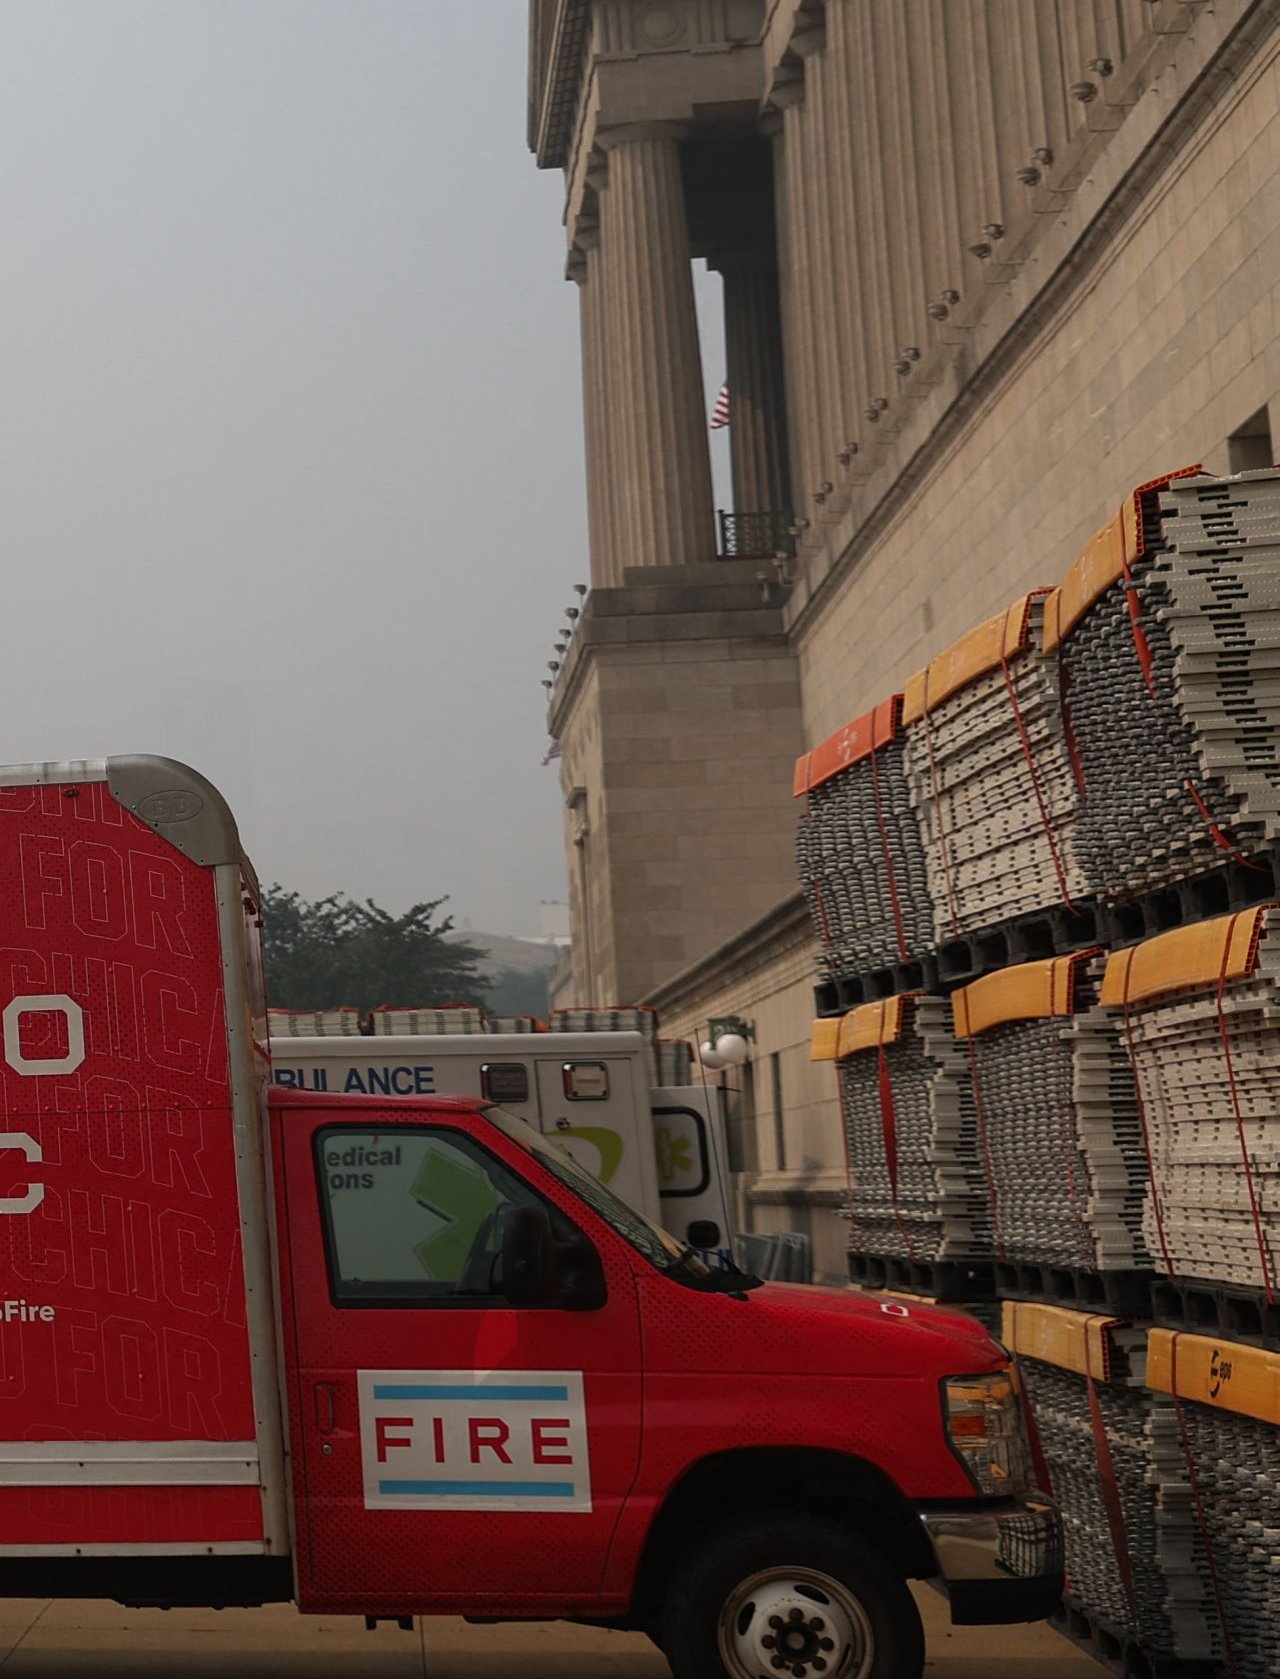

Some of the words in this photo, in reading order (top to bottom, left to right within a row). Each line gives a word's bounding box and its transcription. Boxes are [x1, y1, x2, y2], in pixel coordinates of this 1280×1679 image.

[19, 832, 195, 960] FOR
[274, 1066, 436, 1096] BULANCE
[326, 1145, 401, 1167] edical
[330, 1172, 375, 1190] ons
[7, 1182, 246, 1328] CHIC
[51, 1309, 227, 1441] FOR
[376, 1417, 573, 1465] FIRE
